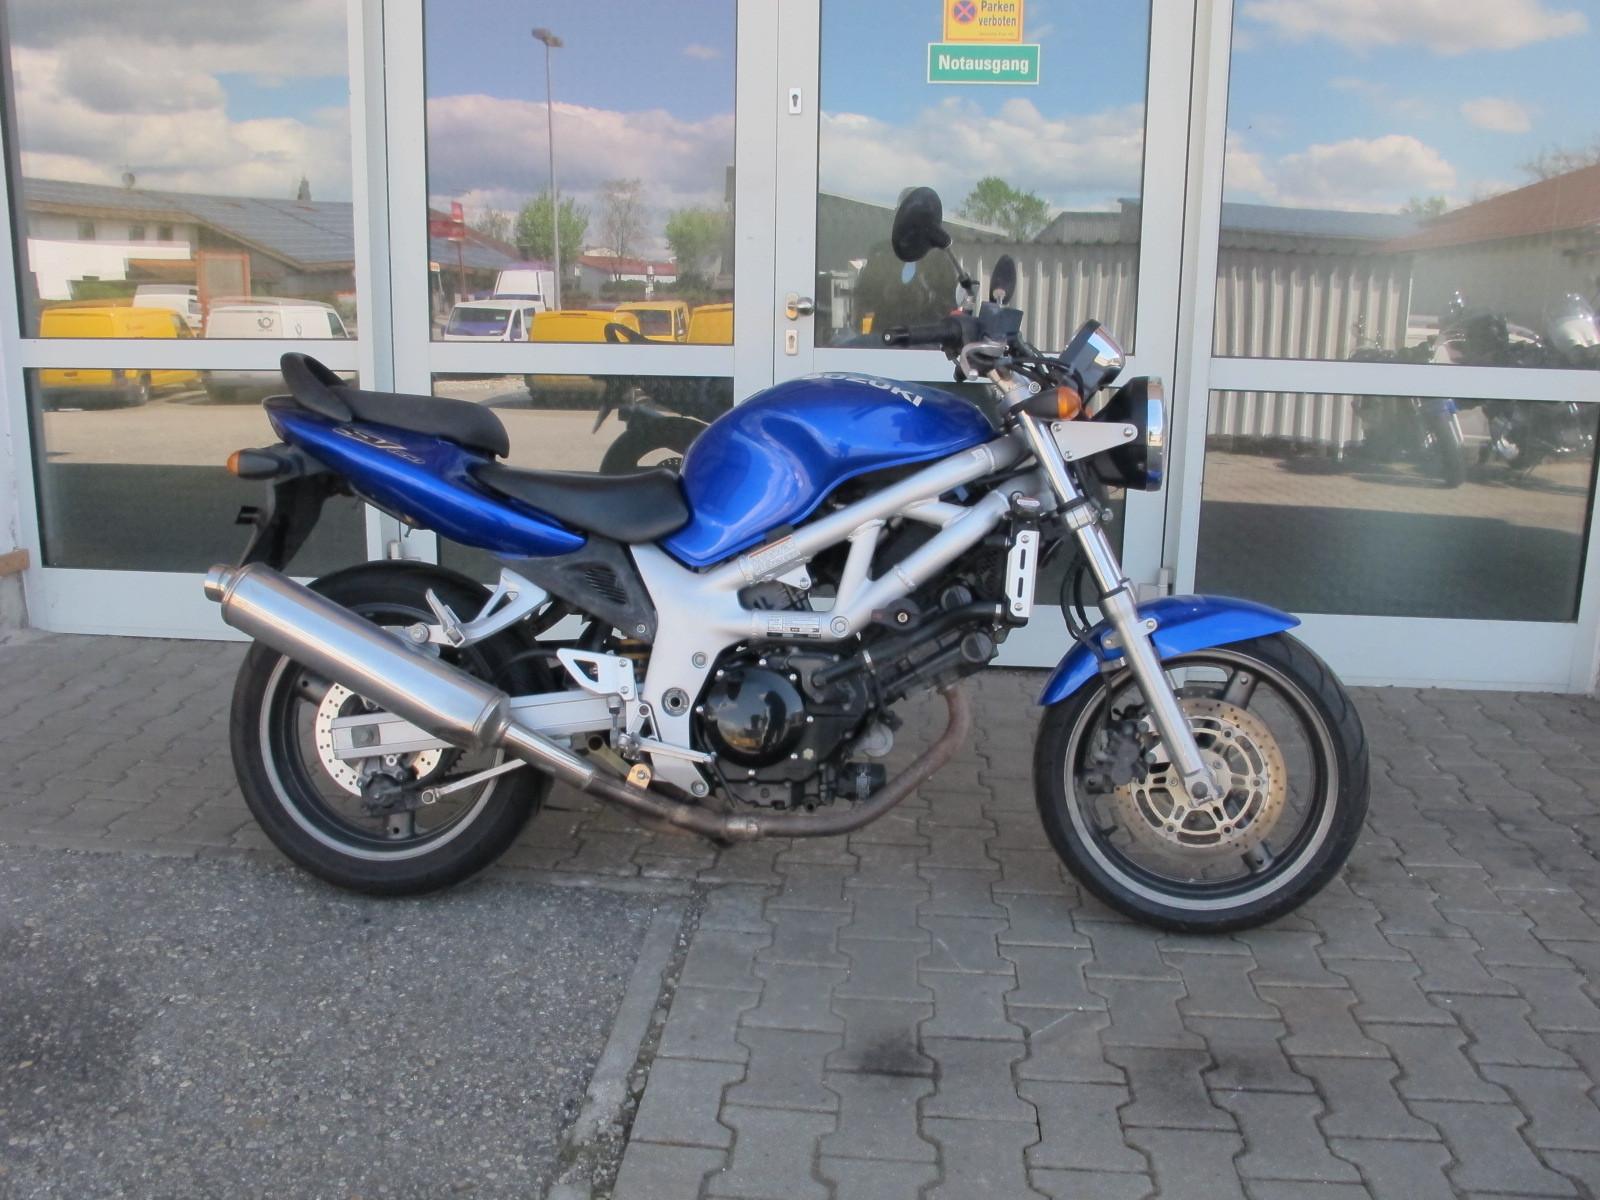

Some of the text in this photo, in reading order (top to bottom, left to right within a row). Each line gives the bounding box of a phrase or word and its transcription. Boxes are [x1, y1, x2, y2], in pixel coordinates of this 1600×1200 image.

[980, 0, 1015, 13] Parken
[978, 15, 1017, 27] verboten
[938, 54, 1029, 74] Notausgang
